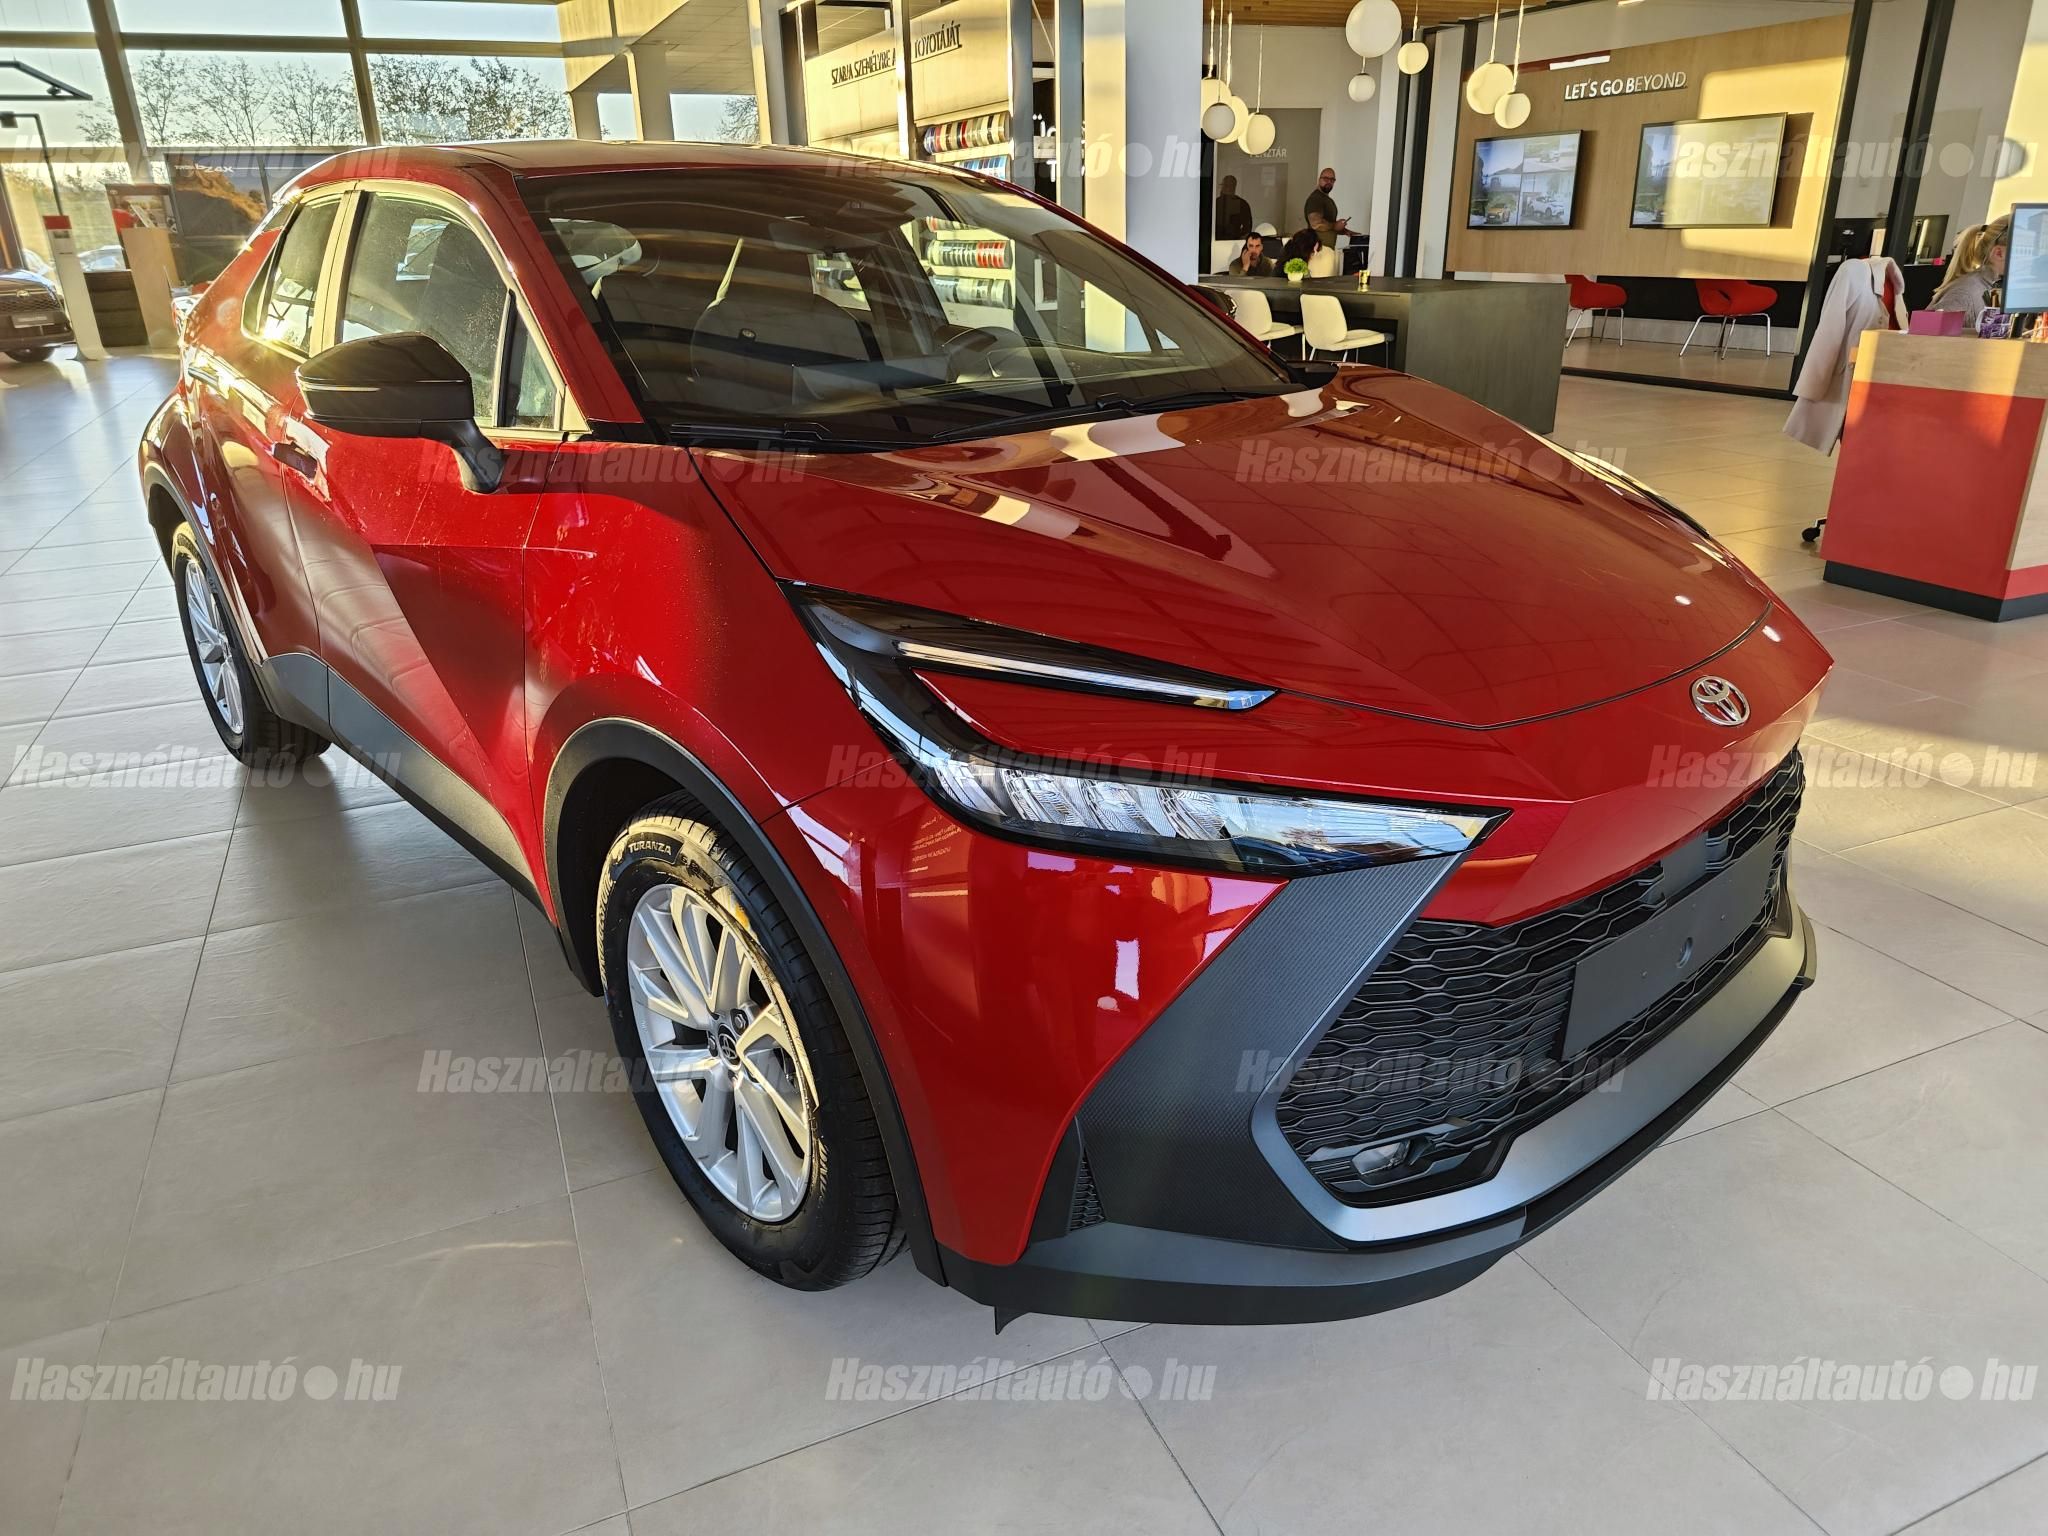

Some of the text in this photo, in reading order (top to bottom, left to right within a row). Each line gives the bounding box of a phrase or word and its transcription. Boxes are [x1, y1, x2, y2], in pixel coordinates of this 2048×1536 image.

[854, 50, 891, 78] SZEMÉLYRE
[914, 20, 961, 59] TOYOTÁJÁT
[1564, 71, 1687, 100] LET'S GO BEYOND
[1249, 146, 1288, 158] ZTÁR
[628, 840, 672, 856] TURANZA
